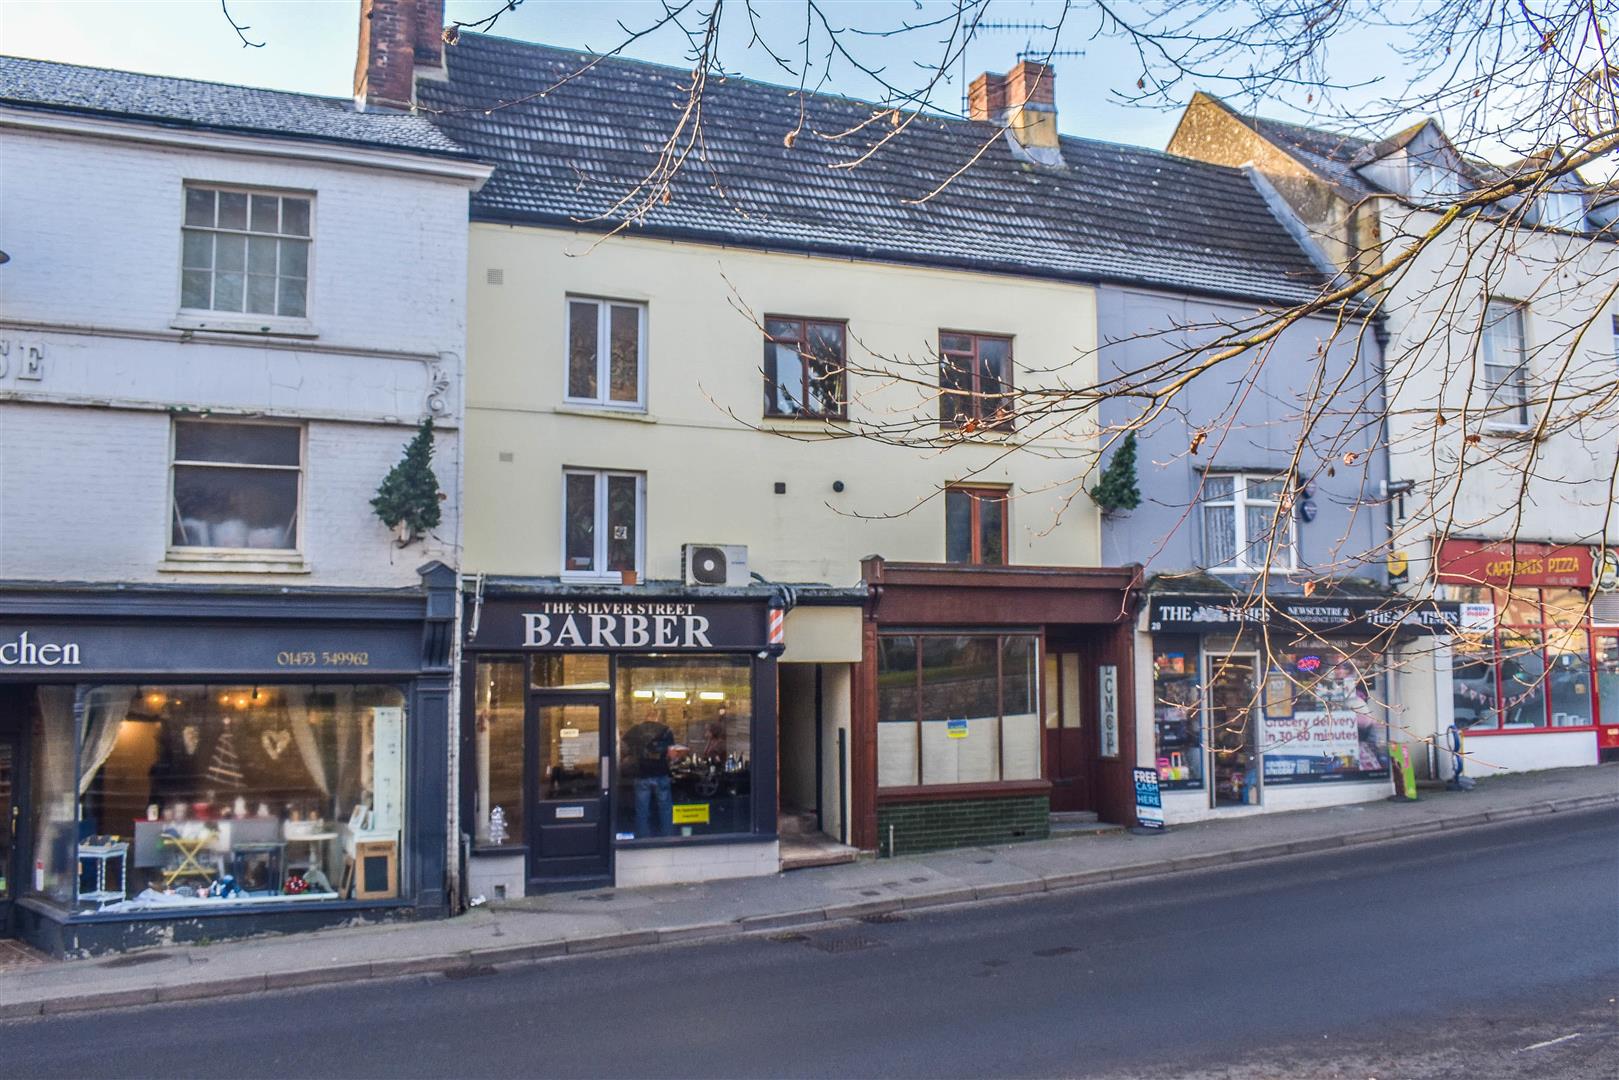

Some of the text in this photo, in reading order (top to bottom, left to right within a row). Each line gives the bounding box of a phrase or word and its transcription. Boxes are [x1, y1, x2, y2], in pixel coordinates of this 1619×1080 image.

[1548, 556, 1579, 573] PIZZA
[542, 602, 695, 615] THE SILVER STREET
[1159, 605, 1192, 621] THE
[1365, 609, 1393, 624] THE
[521, 613, 713, 648] BARBER
[0, 630, 81, 666] chen
[277, 651, 370, 666] 01453 549962
[1312, 715, 1357, 729] delivery
[1313, 728, 1358, 741] minutes
[1133, 770, 1158, 785] FREE
[1136, 783, 1159, 792] CASH
[1137, 794, 1160, 807] HERE
